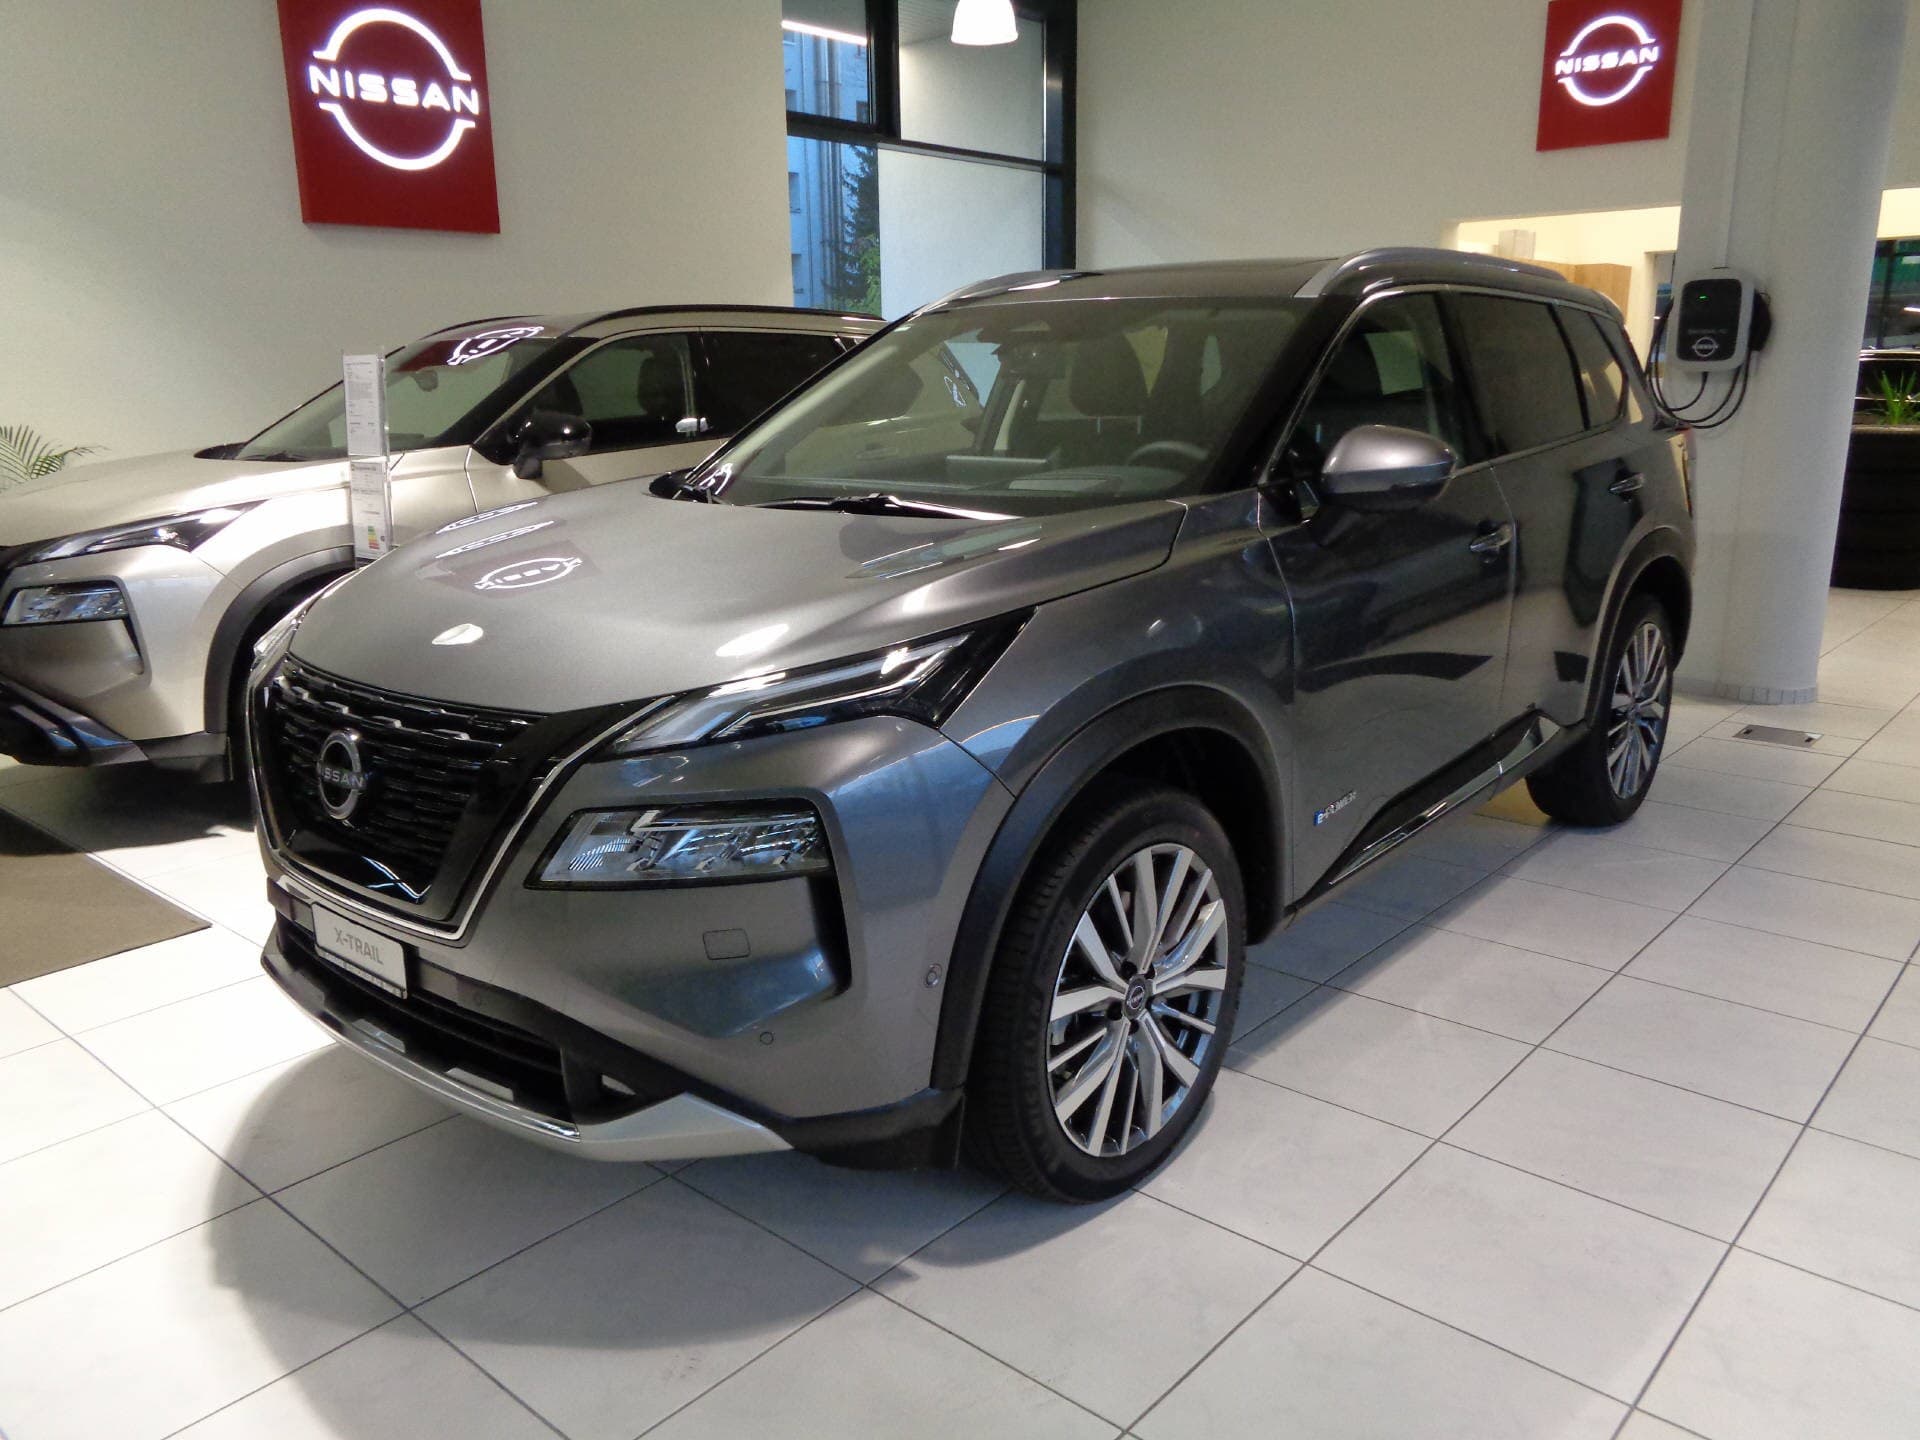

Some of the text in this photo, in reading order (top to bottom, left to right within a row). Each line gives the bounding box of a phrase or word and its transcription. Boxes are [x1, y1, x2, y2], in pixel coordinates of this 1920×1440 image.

[1554, 45, 1659, 76] NISSAN
[308, 64, 480, 115] NISSAN
[334, 927, 384, 966] X-TRAIL
